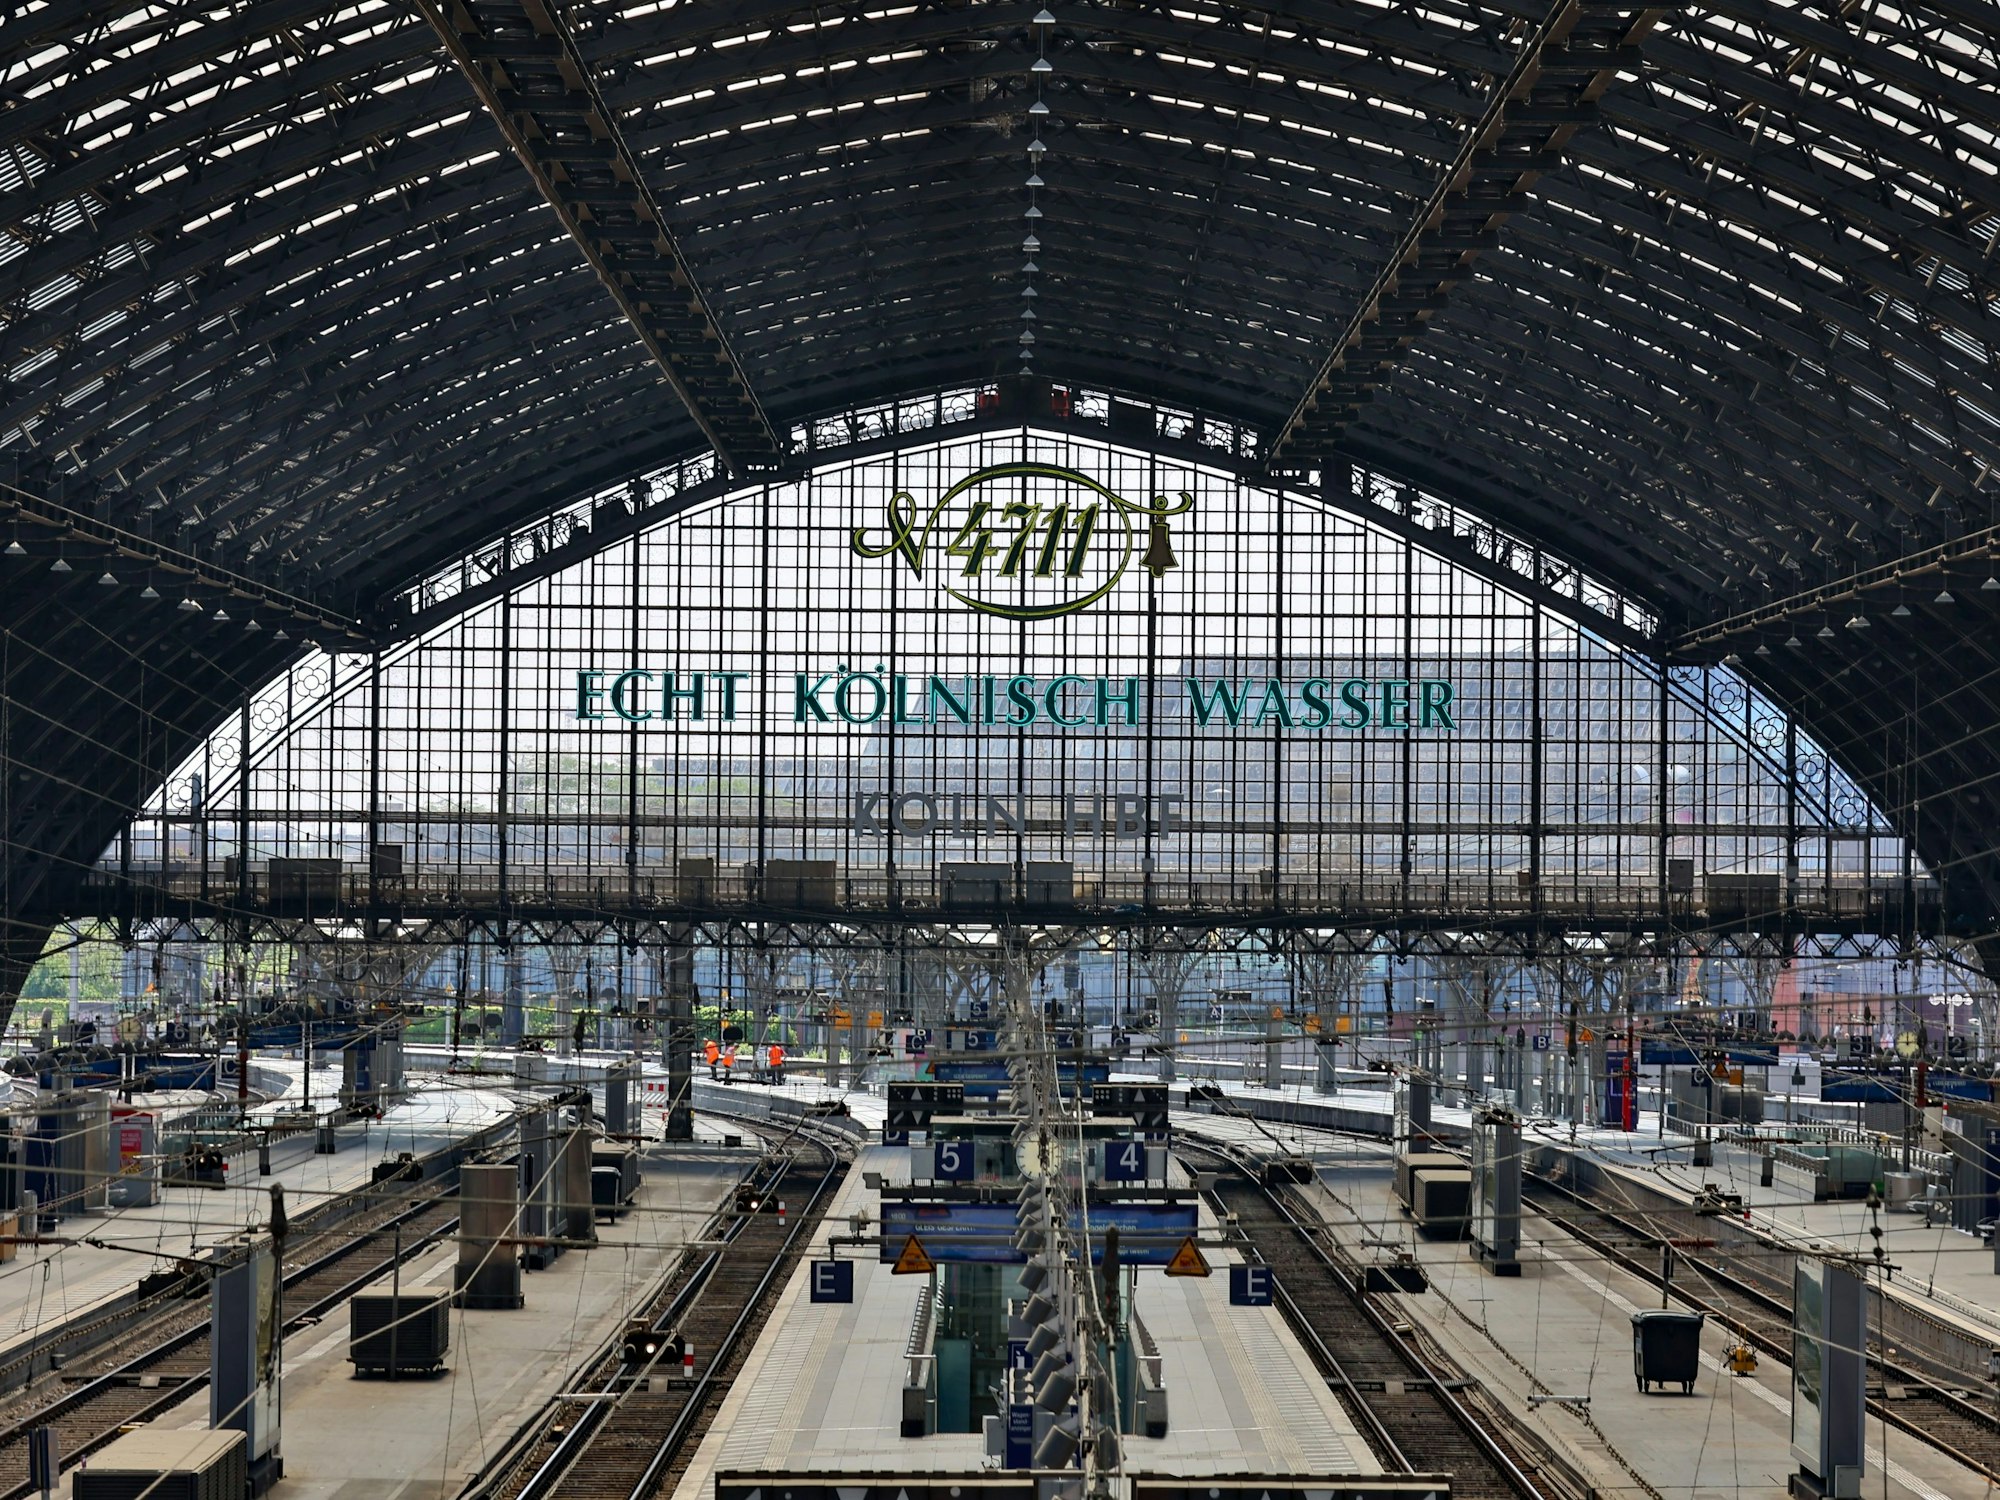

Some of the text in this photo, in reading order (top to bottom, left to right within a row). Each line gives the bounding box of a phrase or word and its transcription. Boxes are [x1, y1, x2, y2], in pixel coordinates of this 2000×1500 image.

[945, 502, 1102, 578] 4711
[576, 663, 1457, 731] ECHT KÖLNISCH WASSER
[854, 790, 1184, 840] KÖLN HBF
[973, 1002, 982, 1015] 5
[174, 1025, 185, 1040] 6
[968, 1032, 979, 1047] 5
[911, 1035, 923, 1050] C
[1538, 1036, 1547, 1049] B
[1852, 1036, 1864, 1052] 3
[1951, 1037, 1963, 1054] 2
[1693, 1068, 1705, 1083] C
[941, 1142, 960, 1172] 5
[1119, 1142, 1139, 1173] 4
[816, 1261, 836, 1294] E
[1247, 1267, 1267, 1297] E
